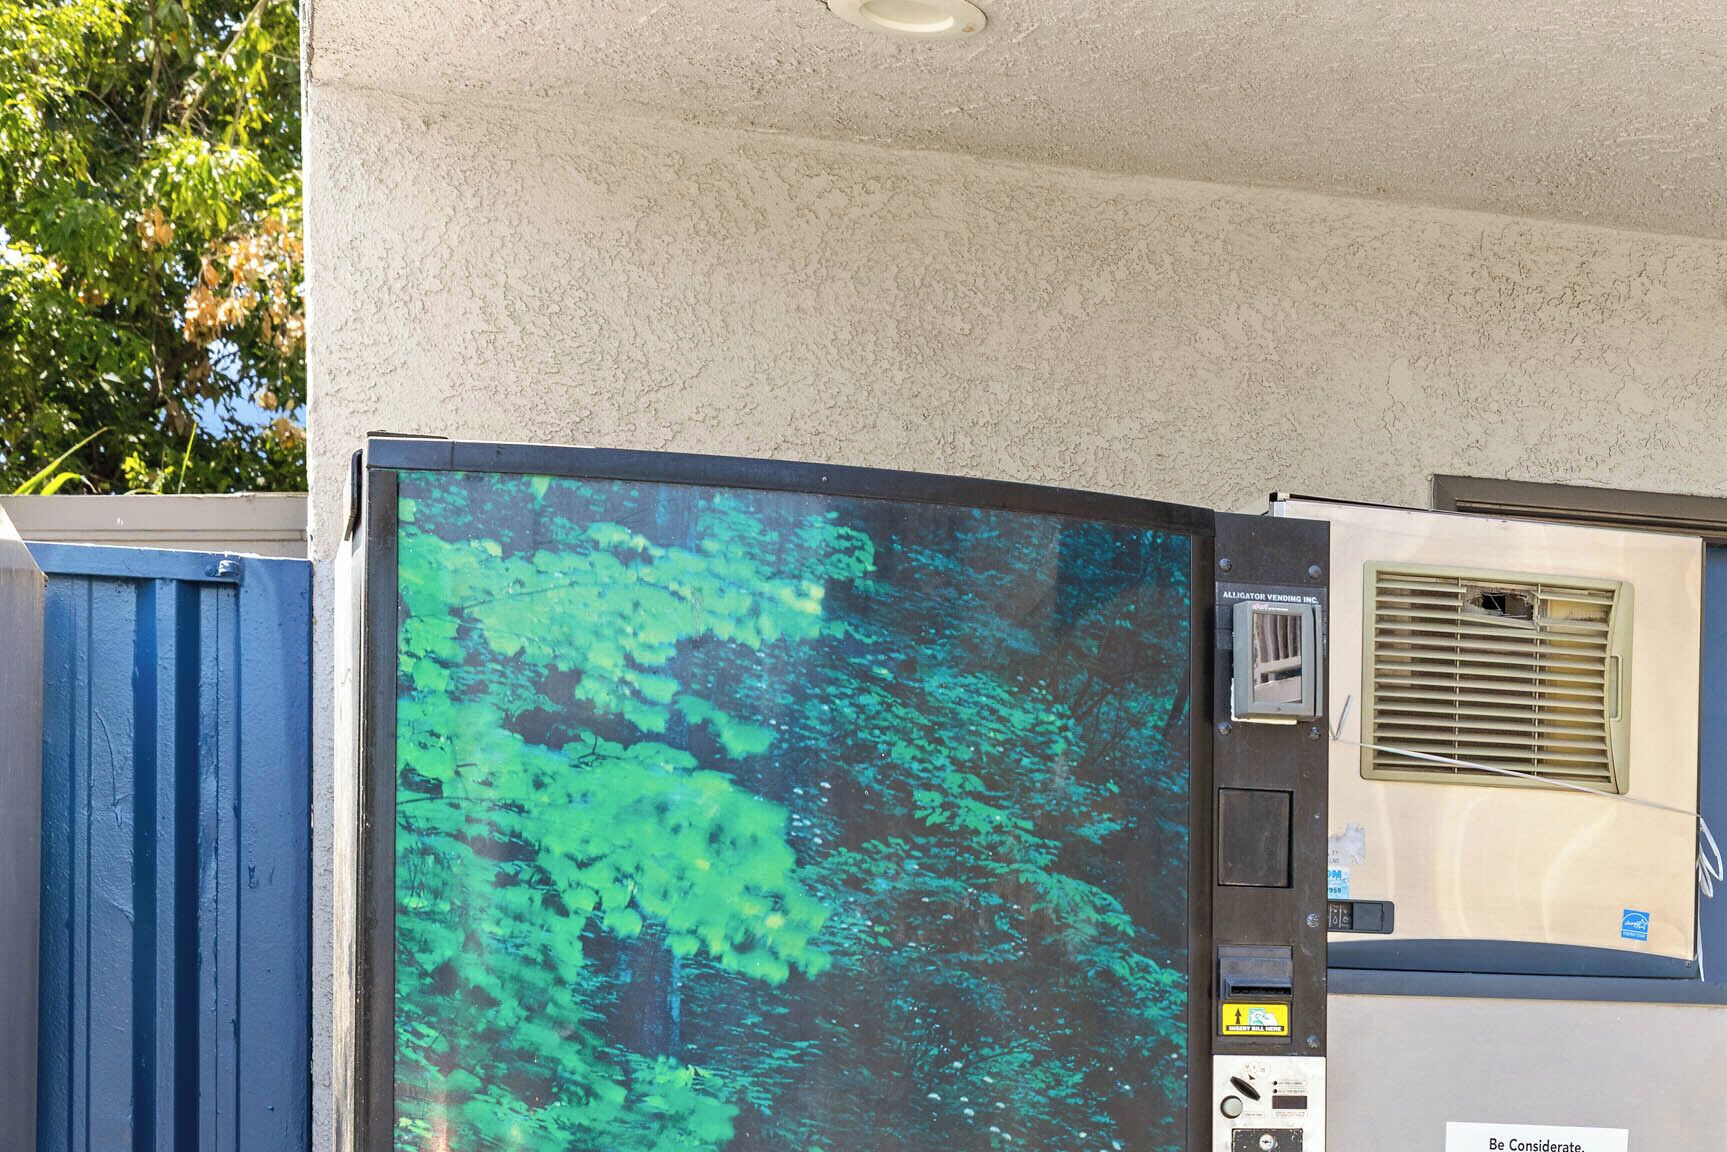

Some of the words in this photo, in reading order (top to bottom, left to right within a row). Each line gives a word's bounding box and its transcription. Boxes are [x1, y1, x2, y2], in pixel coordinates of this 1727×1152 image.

[1222, 591, 1266, 601] ALLIGATOR
[1267, 594, 1302, 603] VENDING
[1303, 596, 1320, 604] INC.
[1488, 1137, 1505, 1151] Be
